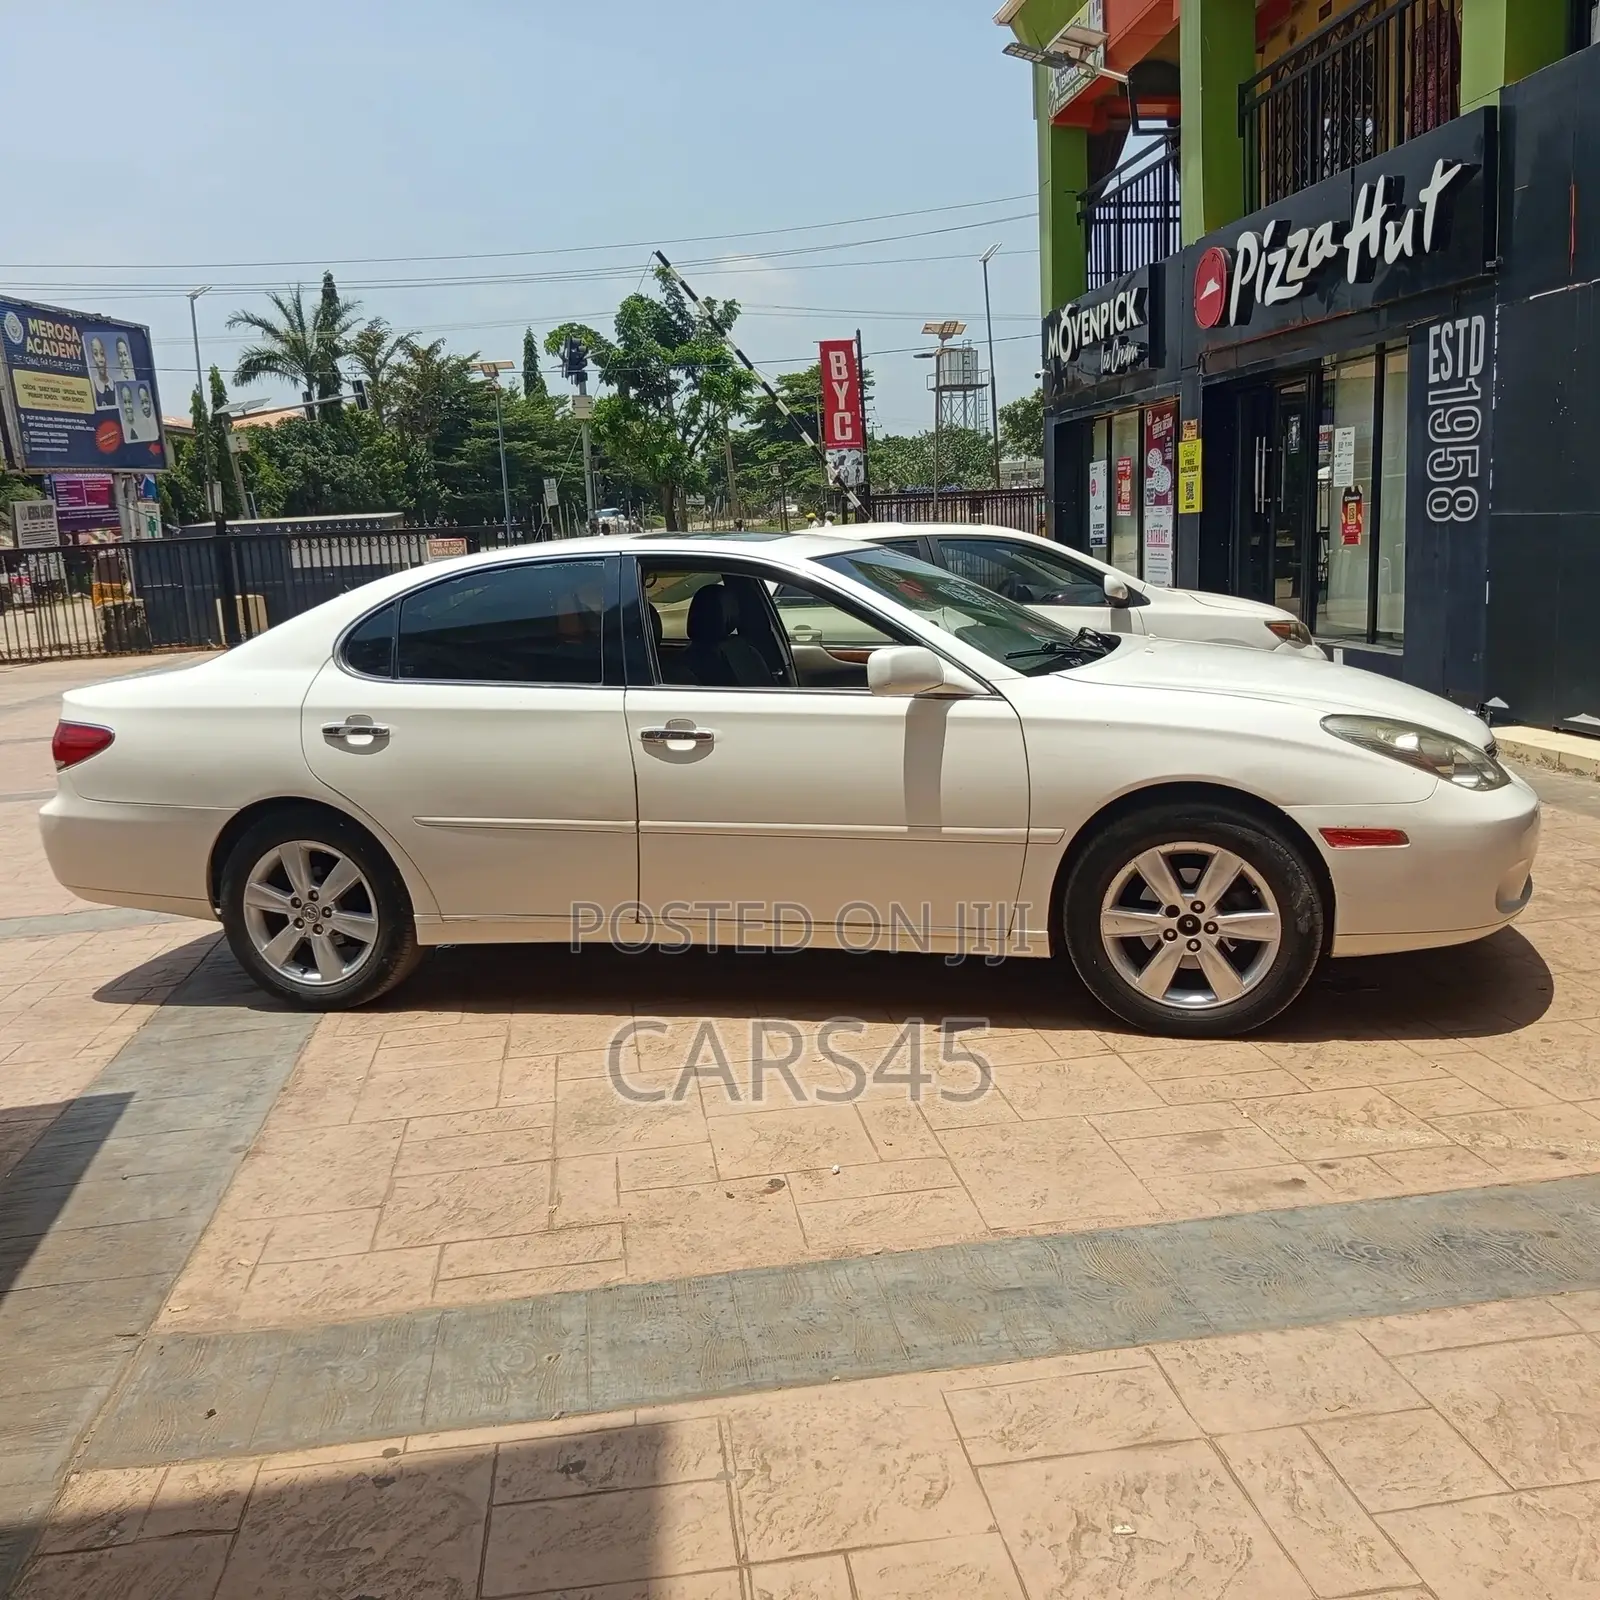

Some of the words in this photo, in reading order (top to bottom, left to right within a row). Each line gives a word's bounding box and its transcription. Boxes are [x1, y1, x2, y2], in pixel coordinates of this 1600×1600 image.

[1229, 219, 1342, 327] Pizza
[1344, 158, 1461, 284] Hut
[26, 336, 82, 361] ACADEMY
[28, 317, 81, 344] MEROSA
[1100, 340, 1111, 374] Ice
[1111, 339, 1141, 373] Cream
[1428, 315, 1486, 384] ESTD
[829, 351, 852, 440] BYC
[1426, 377, 1483, 522] 1958
[432, 547, 449, 556] OWN
[449, 546, 464, 555] RISK
